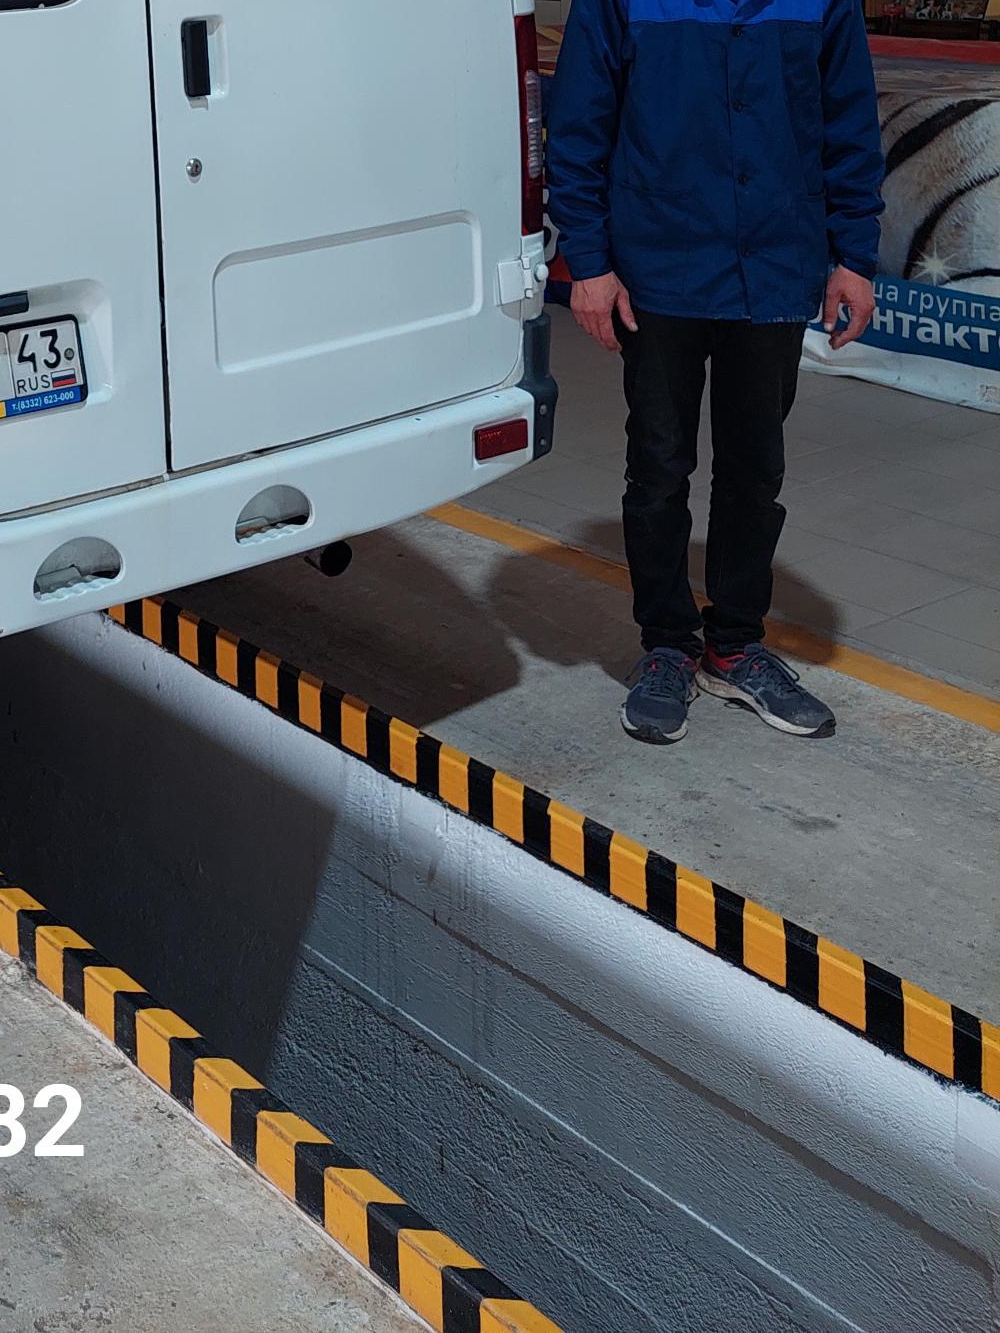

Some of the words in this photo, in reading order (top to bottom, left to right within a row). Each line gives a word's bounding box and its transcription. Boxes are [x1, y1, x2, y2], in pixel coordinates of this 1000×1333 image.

[908, 289, 1000, 322] группа
[17, 328, 62, 373] 43
[16, 374, 51, 395] RUS
[43, 390, 75, 405] 623-000
